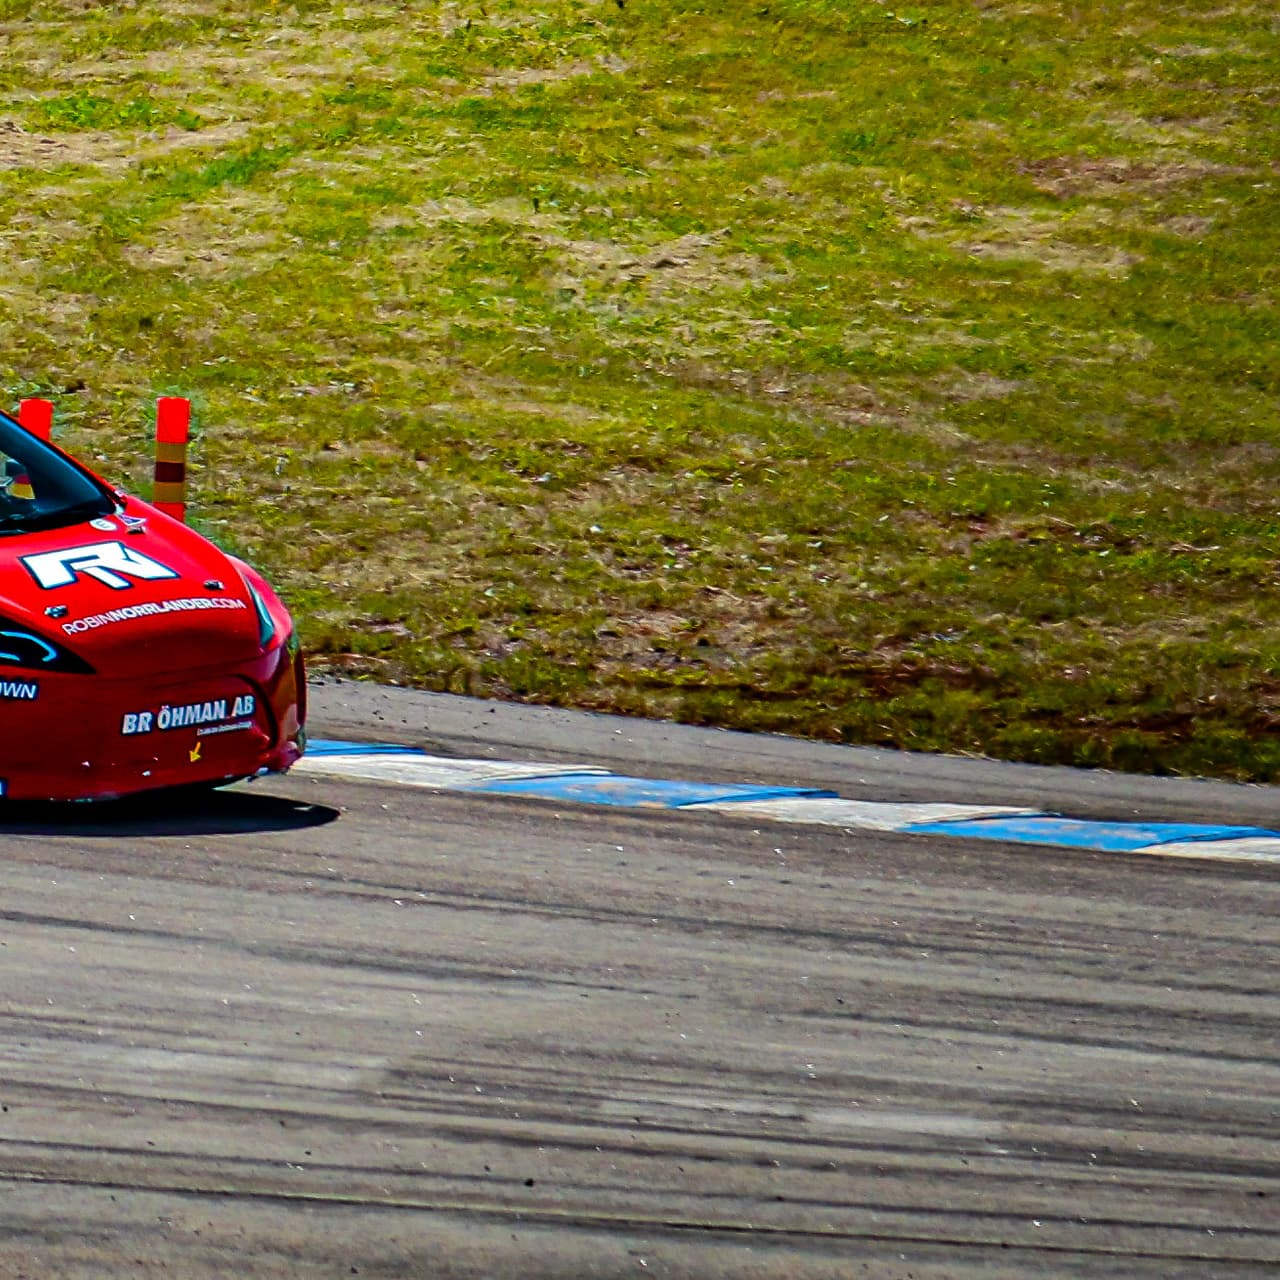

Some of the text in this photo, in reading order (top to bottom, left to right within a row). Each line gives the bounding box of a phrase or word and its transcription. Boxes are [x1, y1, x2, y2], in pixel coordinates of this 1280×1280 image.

[61, 596, 248, 636] ROBINNORRLANDER.COM
[121, 712, 152, 735] BR
[156, 704, 227, 730] ÖHMAN
[229, 694, 256, 718] AB
